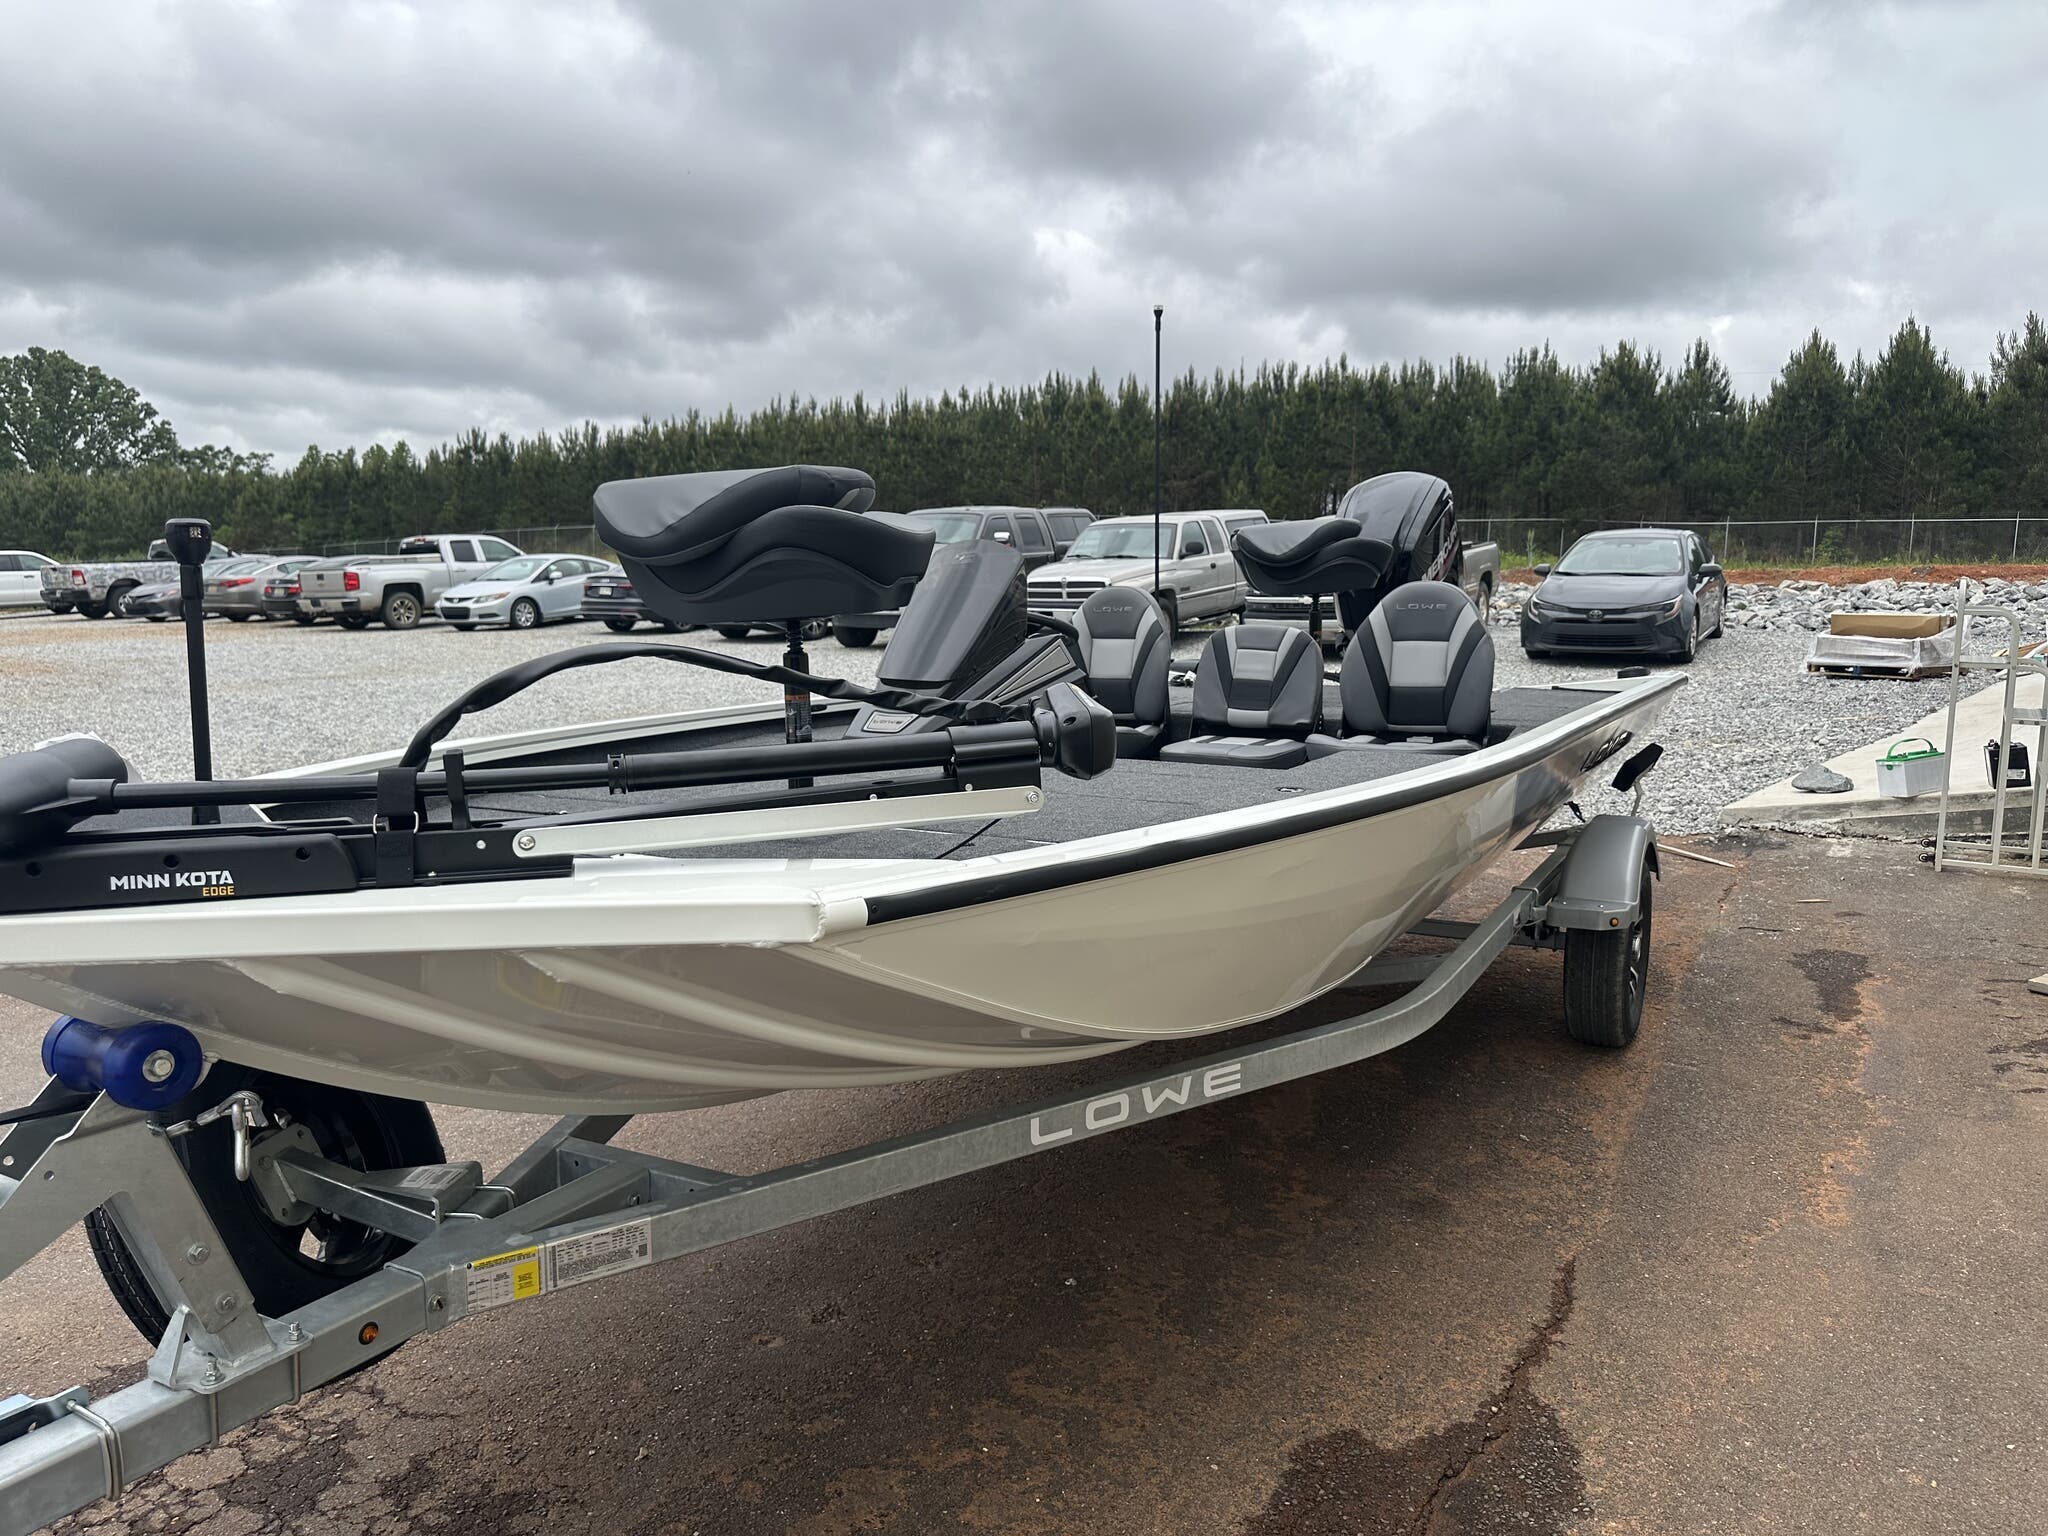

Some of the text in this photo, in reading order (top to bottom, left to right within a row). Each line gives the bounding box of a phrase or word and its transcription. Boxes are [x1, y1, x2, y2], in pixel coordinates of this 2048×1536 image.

[1421, 520, 1458, 581] MERCUR
[1092, 605, 1133, 613] LOWE
[1396, 602, 1449, 610] LOWE
[110, 870, 234, 891] MINN KOTA
[202, 885, 235, 897] EDGE
[1030, 1062, 1242, 1147] LOWE
